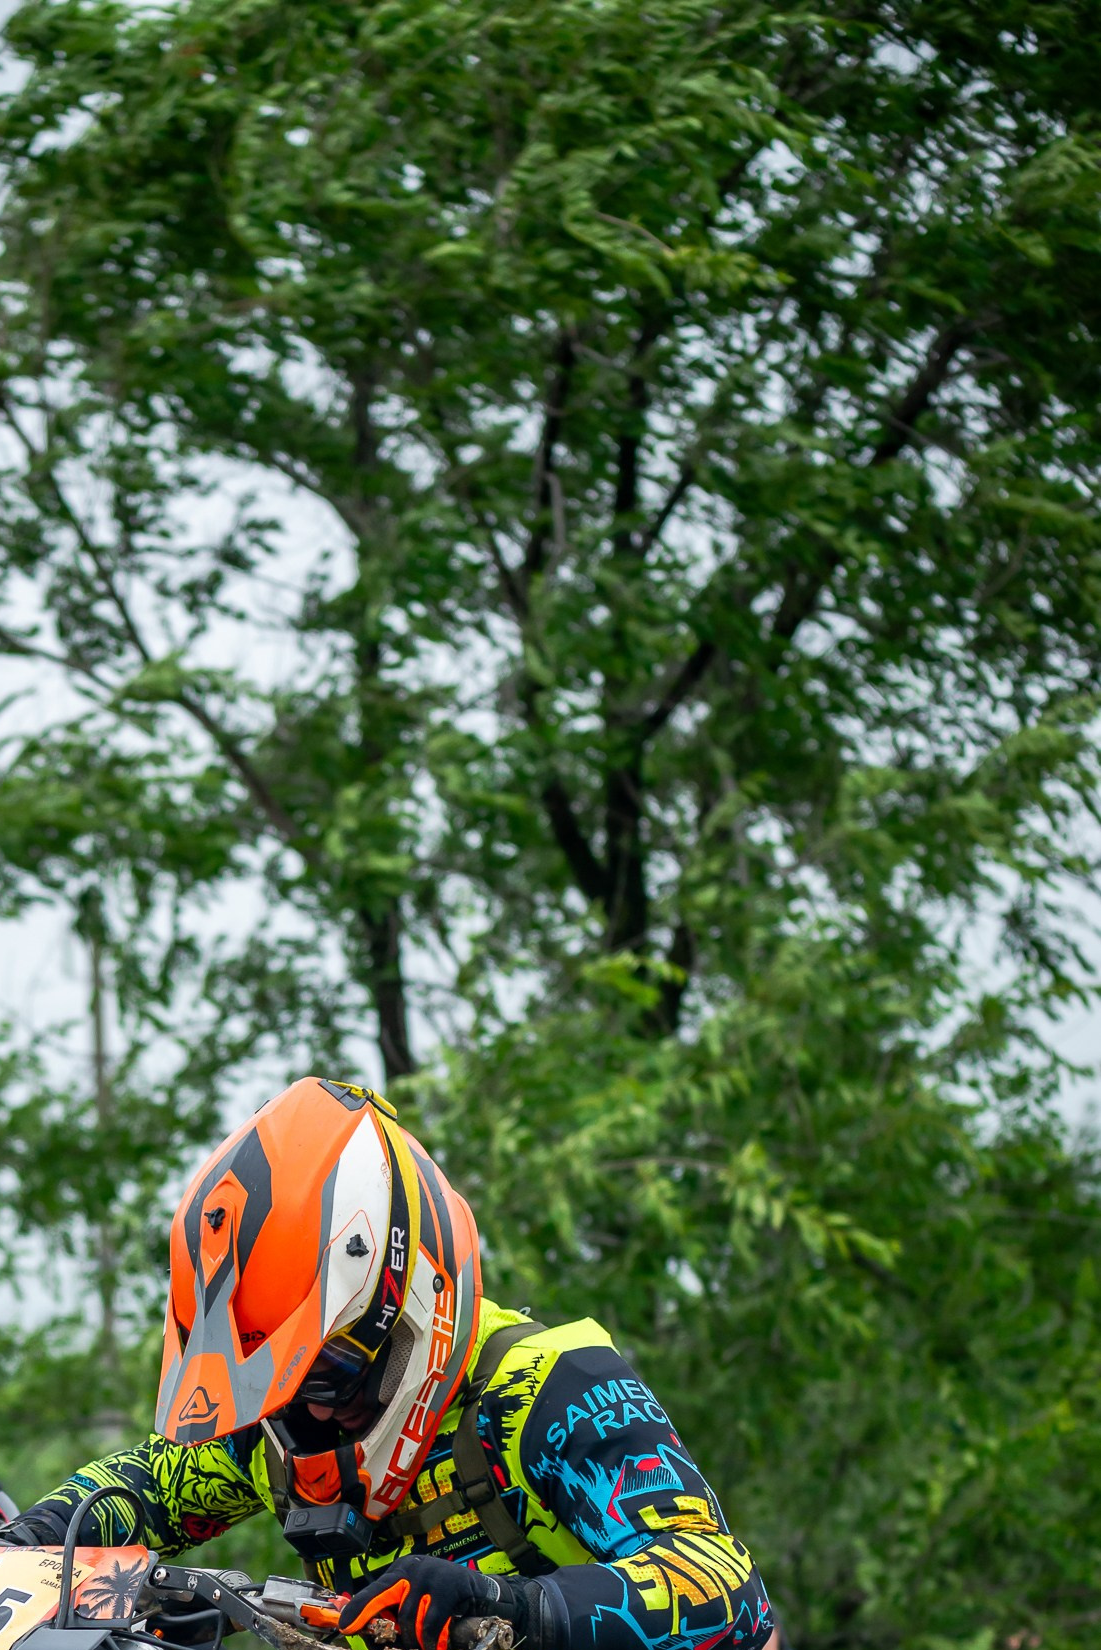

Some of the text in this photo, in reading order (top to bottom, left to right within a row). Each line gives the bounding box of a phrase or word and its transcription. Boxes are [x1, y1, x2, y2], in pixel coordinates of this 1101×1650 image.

[375, 1225, 406, 1330] HIZER
[277, 1345, 307, 1391] ACERBIS
[546, 1378, 658, 1451] SAIMEN
[443, 1533, 478, 1554] SAIMENG
[38, 1558, 82, 1579] БРОА
